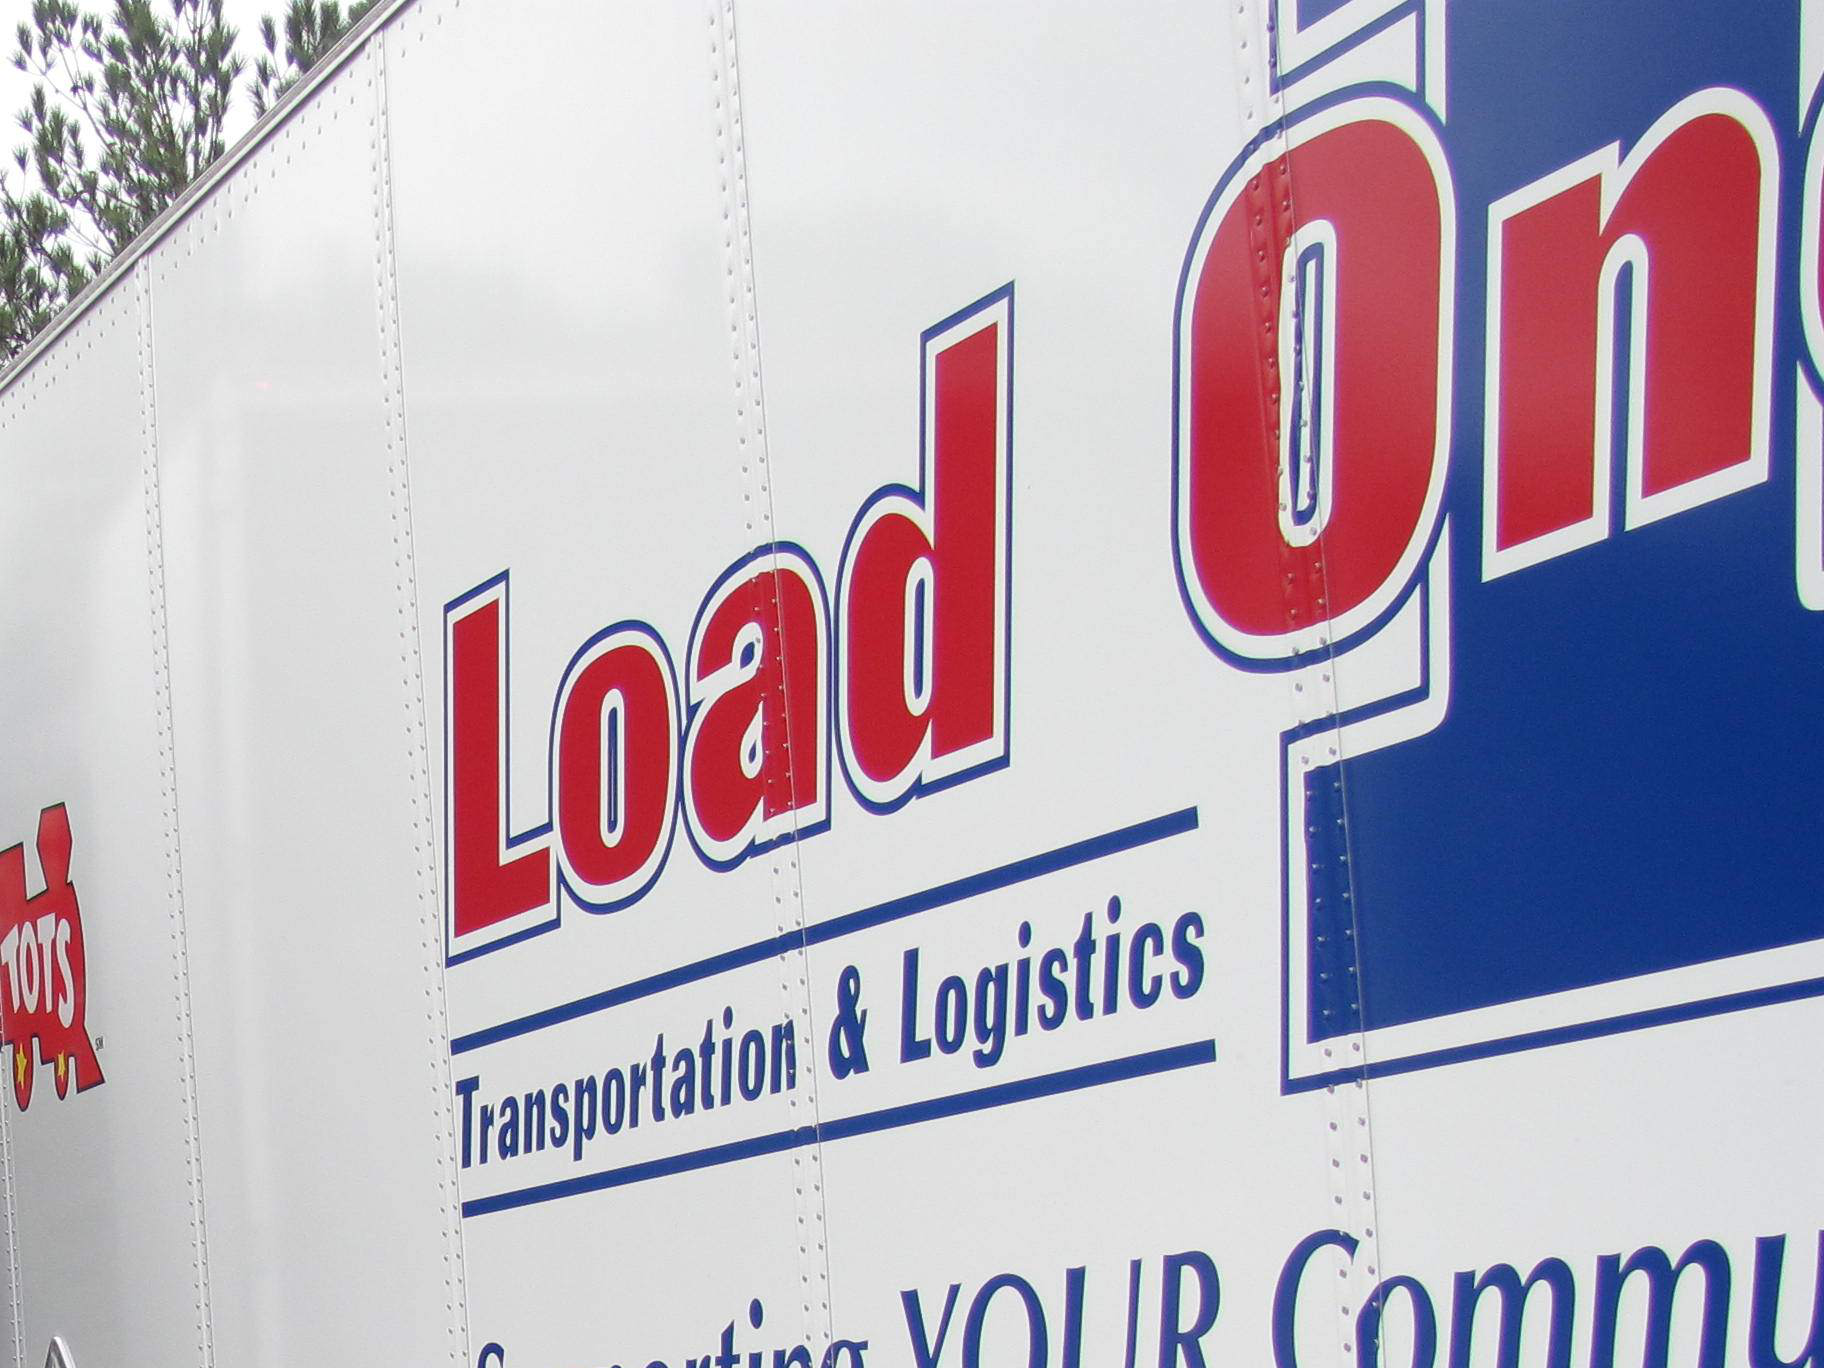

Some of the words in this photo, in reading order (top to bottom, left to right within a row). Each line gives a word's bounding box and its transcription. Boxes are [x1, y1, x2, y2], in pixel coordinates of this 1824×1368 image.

[445, 283, 1014, 970] Load
[1172, 81, 1824, 673] On
[1, 912, 75, 1029] TOTS
[455, 1006, 796, 1169] Transportation
[828, 966, 869, 1080] &
[900, 895, 1204, 1070] Logistics
